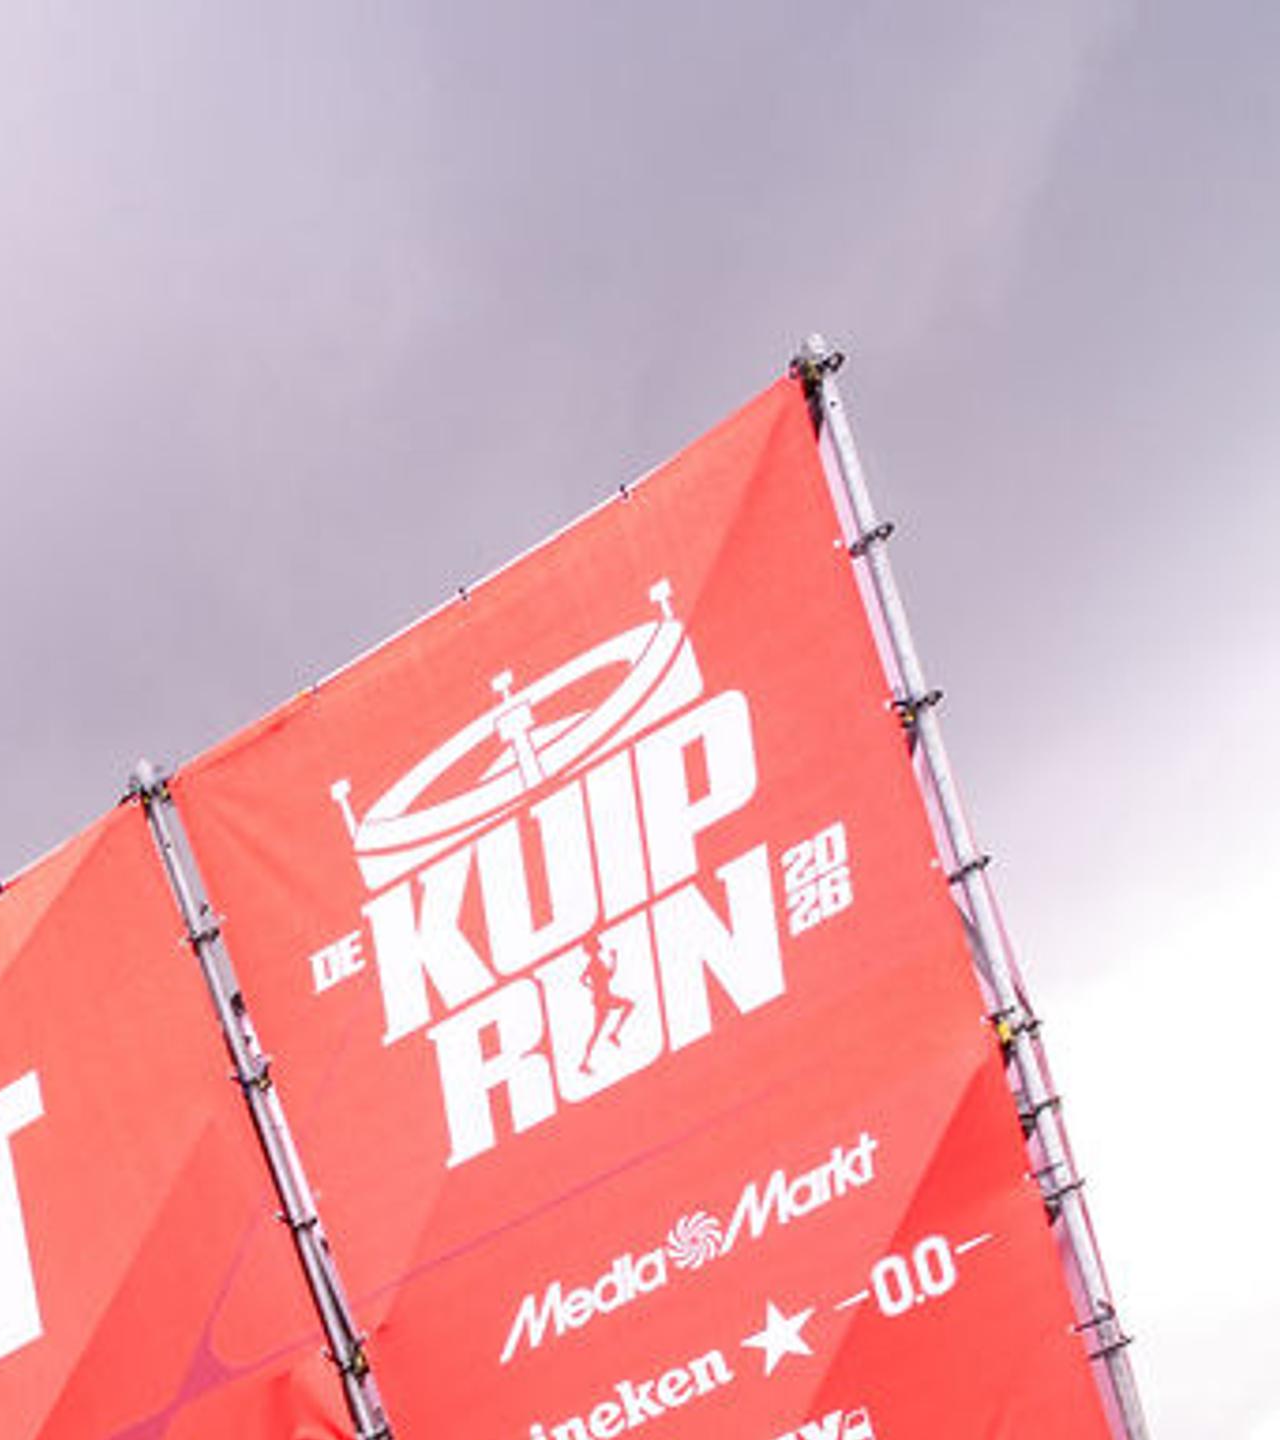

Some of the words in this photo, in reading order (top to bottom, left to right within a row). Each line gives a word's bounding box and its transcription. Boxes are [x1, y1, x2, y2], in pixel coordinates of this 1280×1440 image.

[309, 930, 366, 993] DE
[362, 690, 758, 1045] KUIP
[428, 842, 787, 1168] RUN
